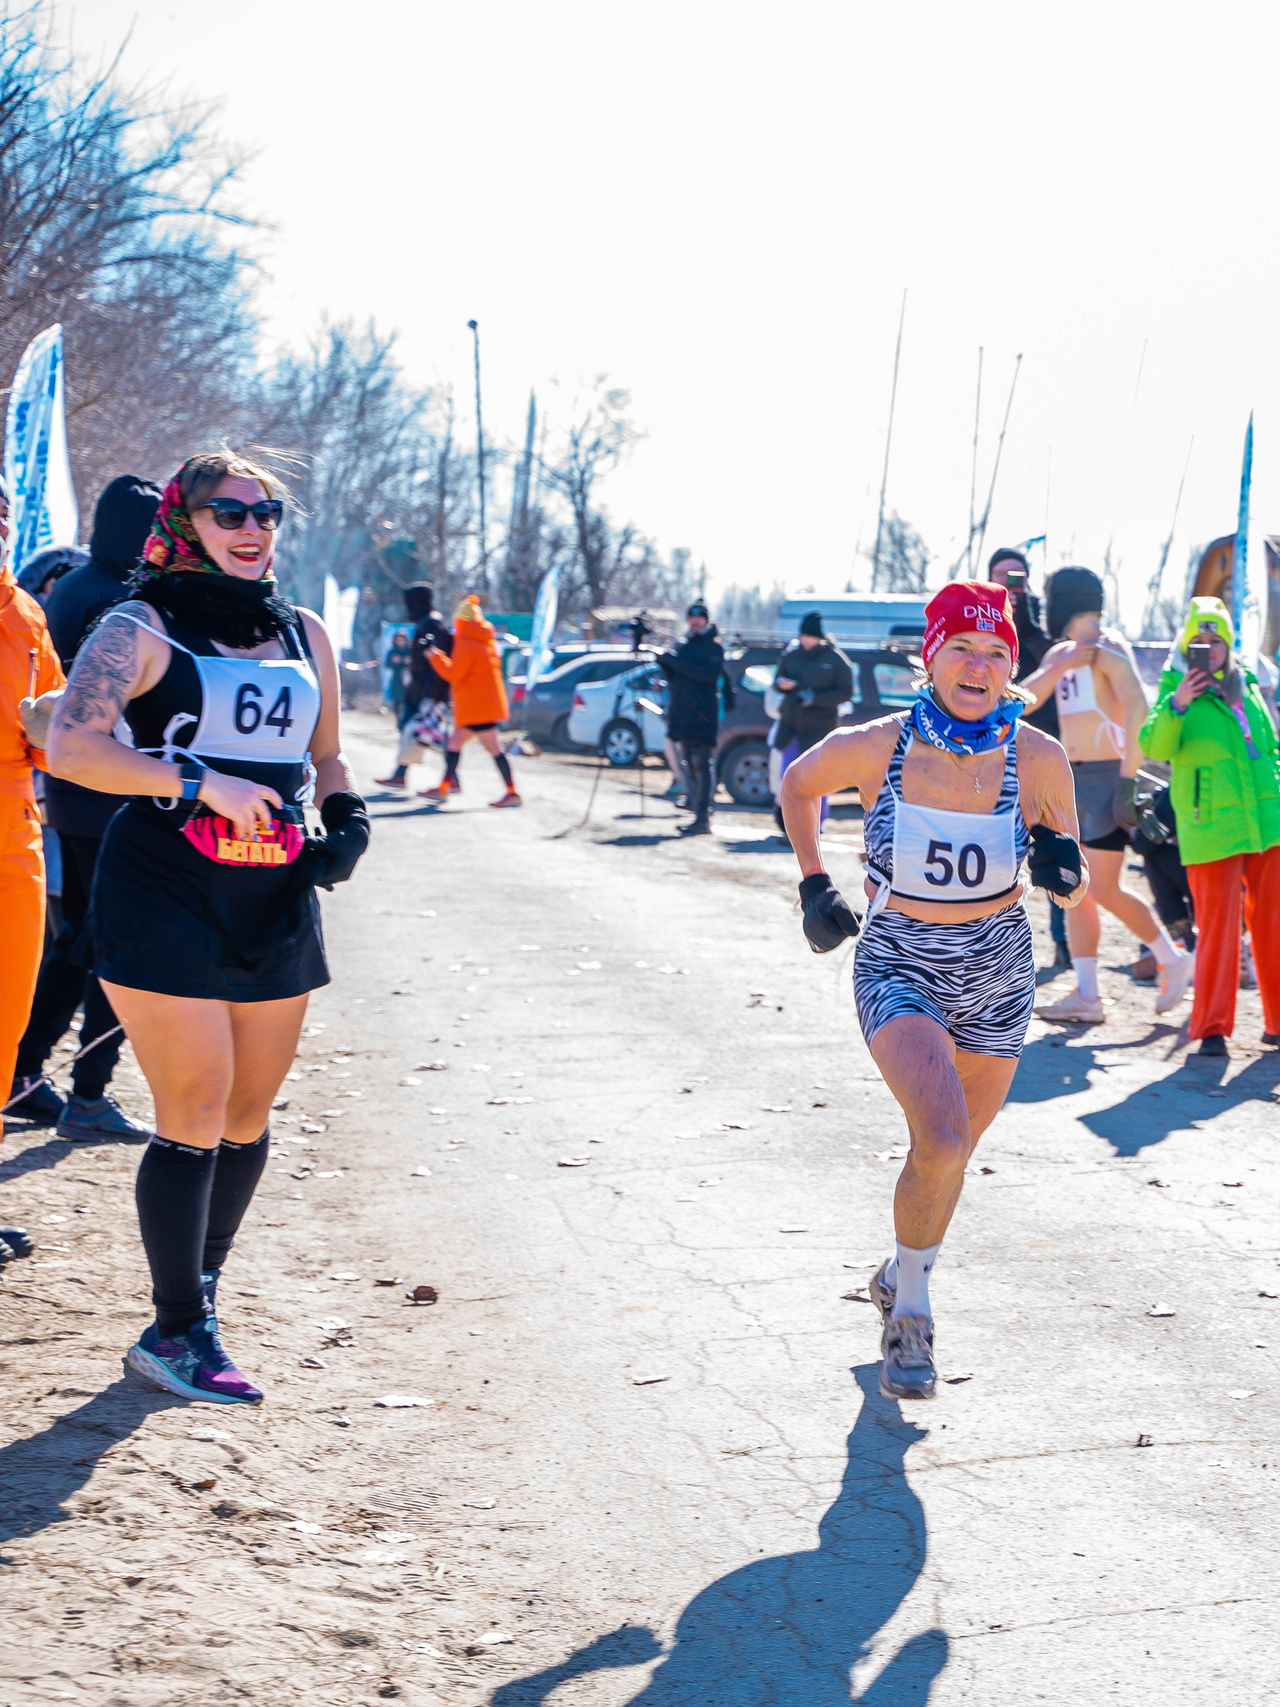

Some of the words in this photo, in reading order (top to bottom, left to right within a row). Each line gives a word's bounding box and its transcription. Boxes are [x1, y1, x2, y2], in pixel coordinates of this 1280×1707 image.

[963, 602, 1003, 623] DNB
[233, 682, 295, 738] 64
[923, 838, 987, 888] 50
